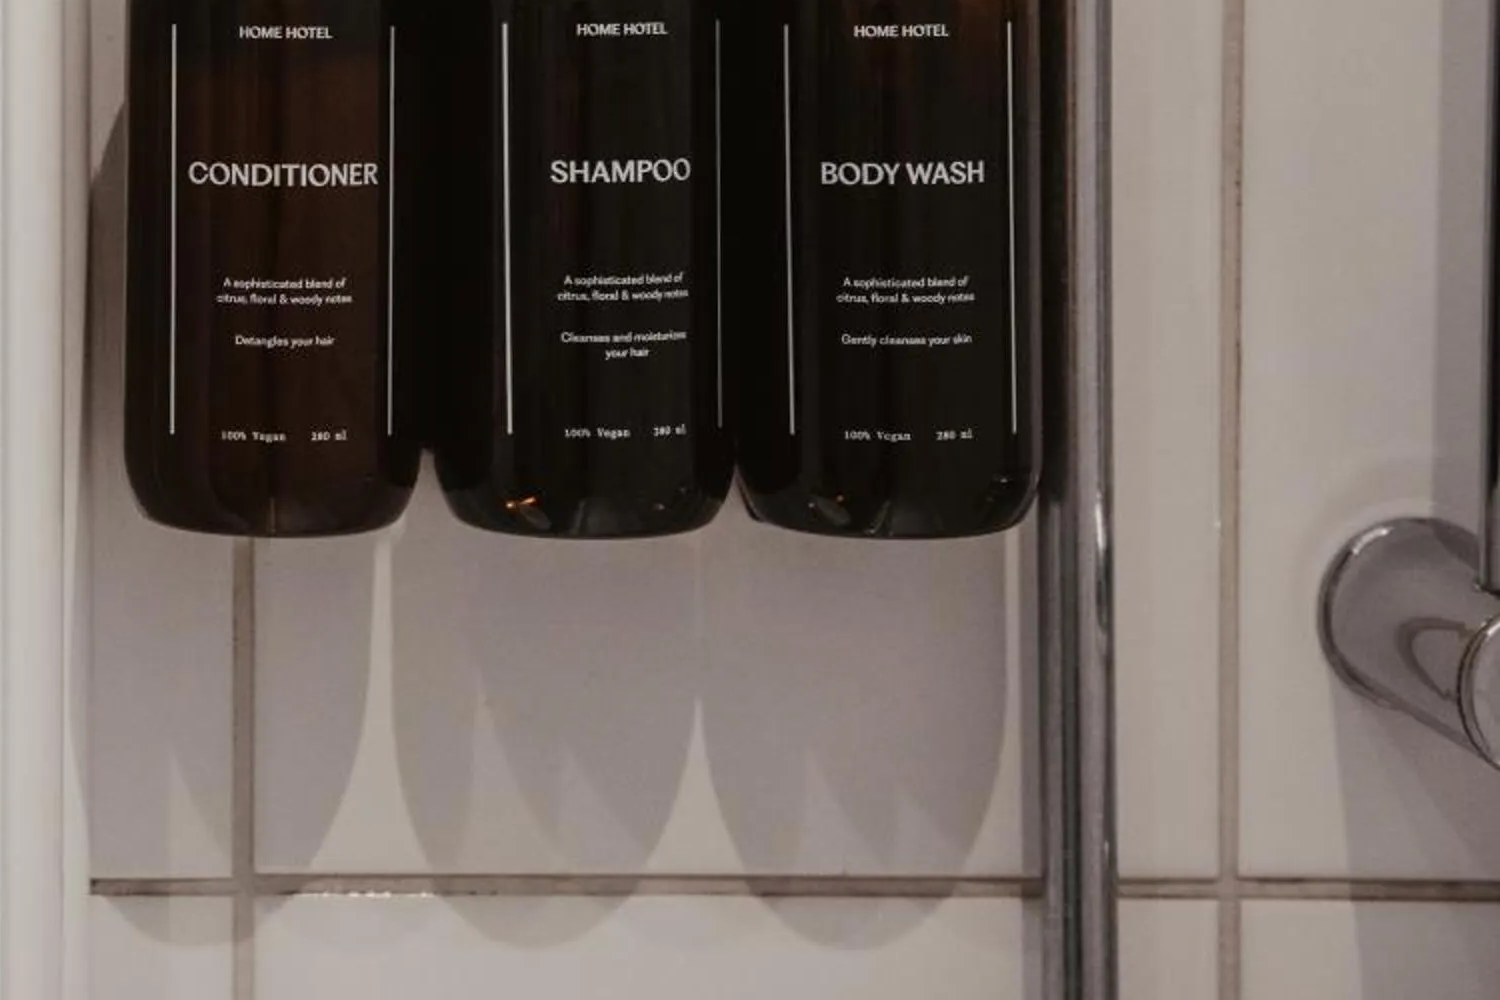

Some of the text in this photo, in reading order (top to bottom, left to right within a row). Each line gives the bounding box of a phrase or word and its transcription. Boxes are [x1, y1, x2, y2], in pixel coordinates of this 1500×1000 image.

[238, 25, 333, 40] HOME HOTEL
[575, 21, 669, 37] HOME HOTEL
[852, 23, 950, 38] HOME HOTEL
[187, 160, 379, 188] CONDITIONER
[549, 157, 692, 185] SHAMPOO
[820, 159, 986, 186] BODY WASH
[222, 276, 348, 291] A sophisticated blend of
[563, 271, 685, 288] A sophisticated blend of
[842, 274, 970, 291] A sophisticated blend of
[249, 292, 277, 305] floral
[278, 293, 289, 305] &
[290, 293, 324, 308] woody
[325, 293, 354, 305] notes
[556, 288, 689, 303] citrus, floral & woody notes
[835, 291, 976, 306] citrus, floral & woody notes
[234, 333, 336, 350] Detangles your hair
[560, 331, 611, 344] Cleanses
[612, 331, 633, 343] and
[840, 332, 973, 349] Gently cleanses your skin
[604, 347, 651, 361] your hair
[221, 430, 287, 444] 100% Vegan
[564, 427, 632, 441] 100% Vegan
[844, 429, 912, 443] 100% Vegan
